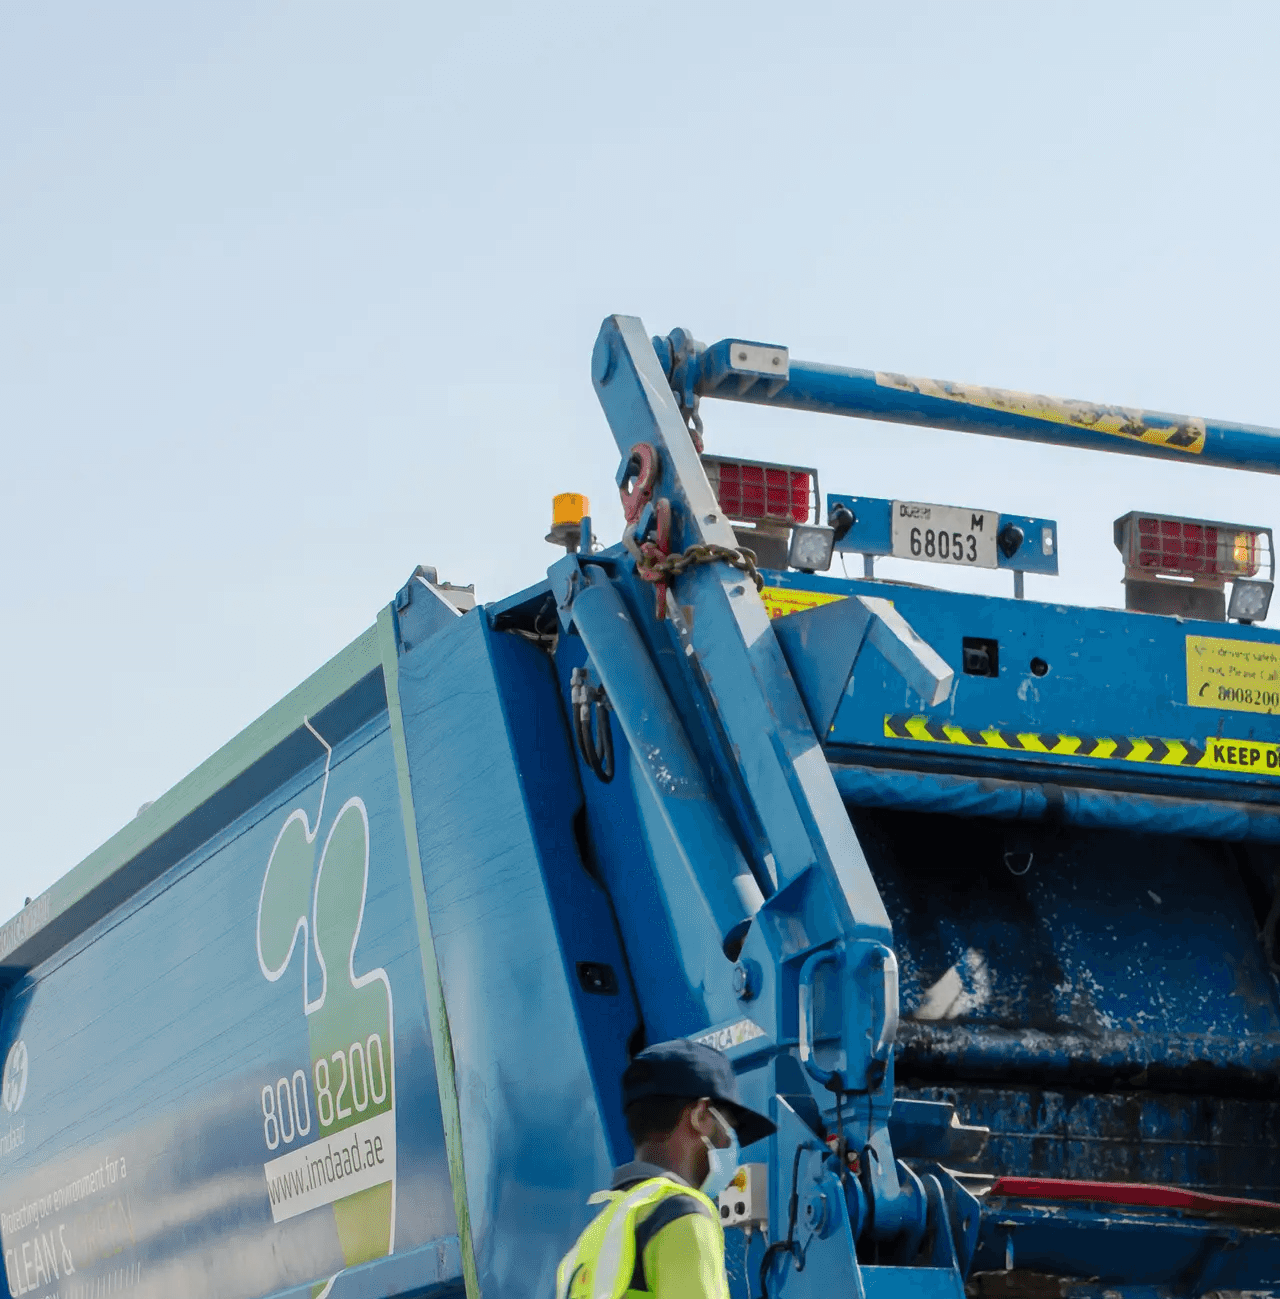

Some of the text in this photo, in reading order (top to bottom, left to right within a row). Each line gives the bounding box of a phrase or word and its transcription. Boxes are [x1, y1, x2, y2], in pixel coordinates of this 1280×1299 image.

[910, 527, 977, 562] 68053
[971, 513, 984, 532] M
[1218, 685, 1280, 707] 8008200
[1213, 744, 1260, 766] KEEP
[261, 1033, 387, 1150] 800 8200
[1, 1201, 40, 1236] Protecting
[105, 1156, 119, 1184] for
[120, 1156, 127, 1179] a
[268, 1132, 385, 1206] www.imdaad.ae
[5, 1230, 60, 1298] CLEAN
[59, 1224, 76, 1276] &
